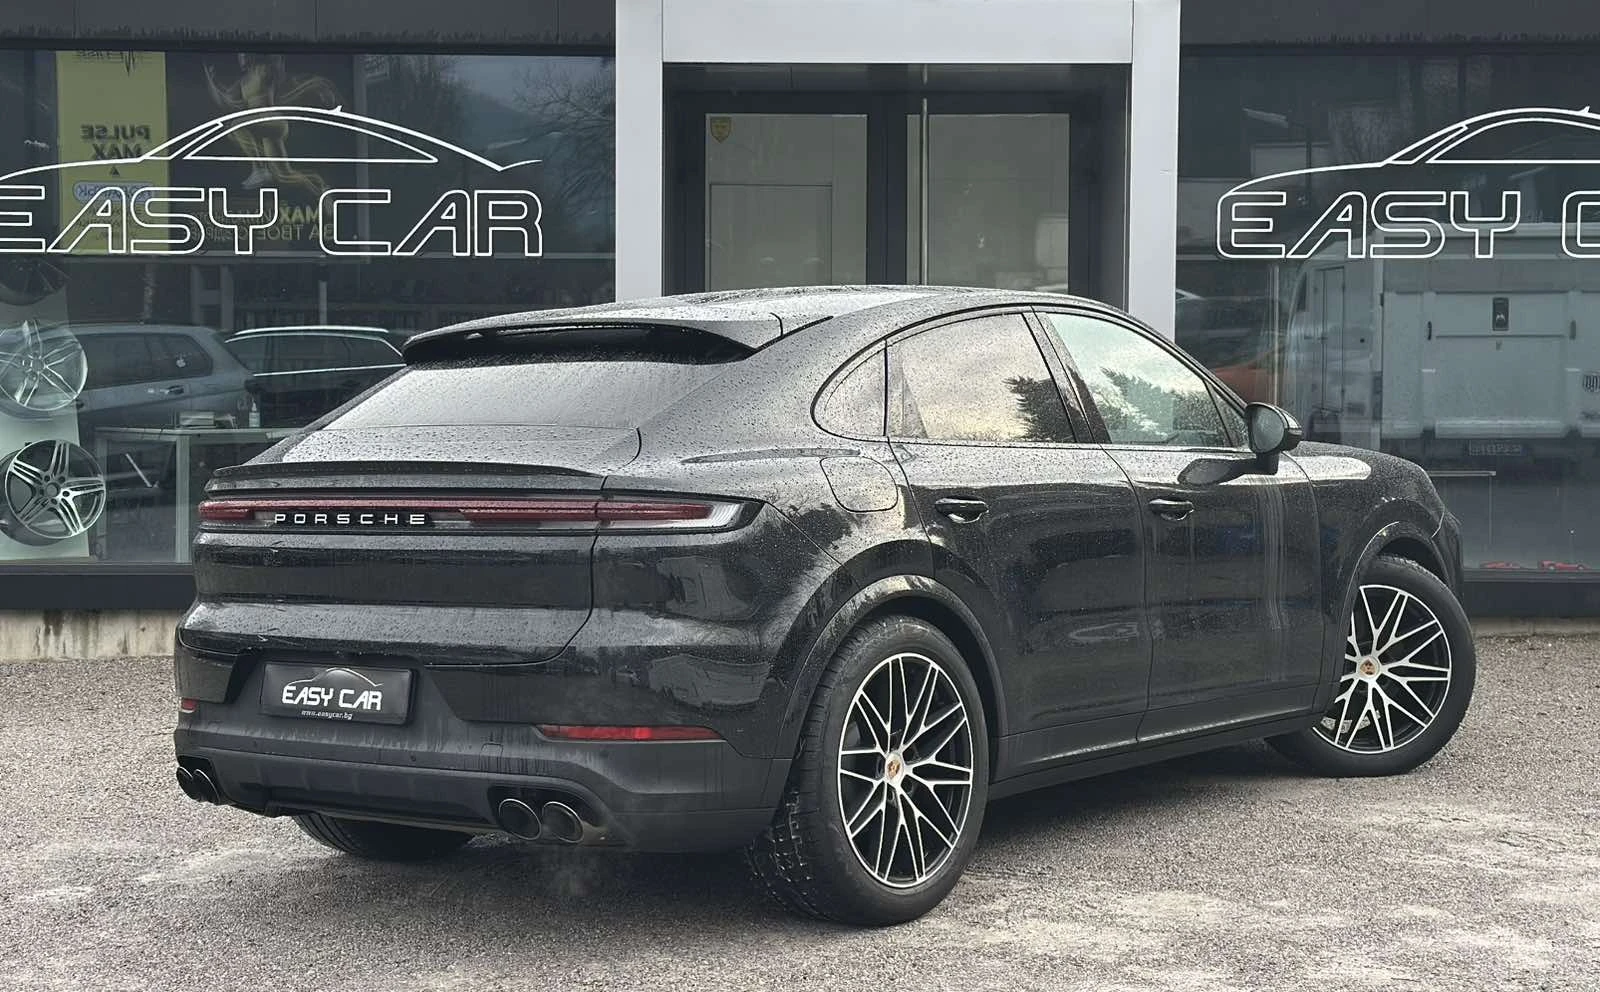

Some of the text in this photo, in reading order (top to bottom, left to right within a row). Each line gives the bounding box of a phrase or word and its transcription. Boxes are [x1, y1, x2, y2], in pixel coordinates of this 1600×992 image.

[0, 186, 279, 255] EASY
[318, 188, 543, 257] CAR
[1217, 190, 1521, 258] EASY
[274, 513, 425, 525] PORSCHE
[281, 685, 383, 711] EASY CAR
[301, 709, 353, 720] www.easycar.bg
